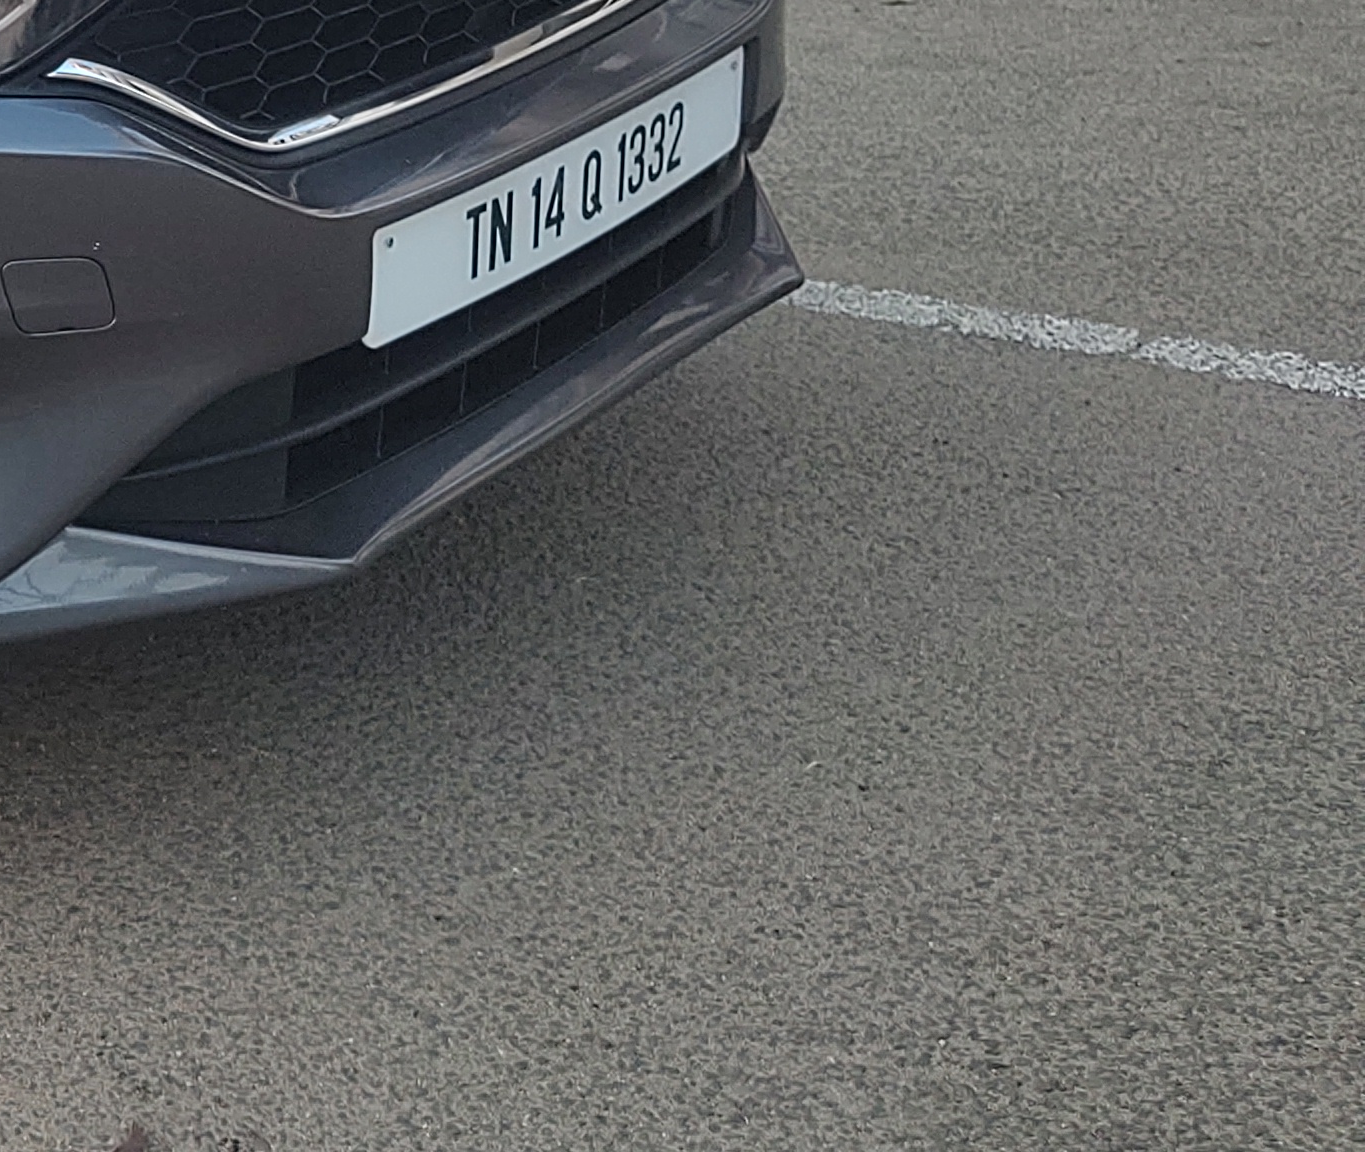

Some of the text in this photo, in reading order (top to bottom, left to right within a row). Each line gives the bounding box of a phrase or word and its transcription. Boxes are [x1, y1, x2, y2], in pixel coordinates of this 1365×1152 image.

[466, 101, 685, 280] TN 14 Q 1332
